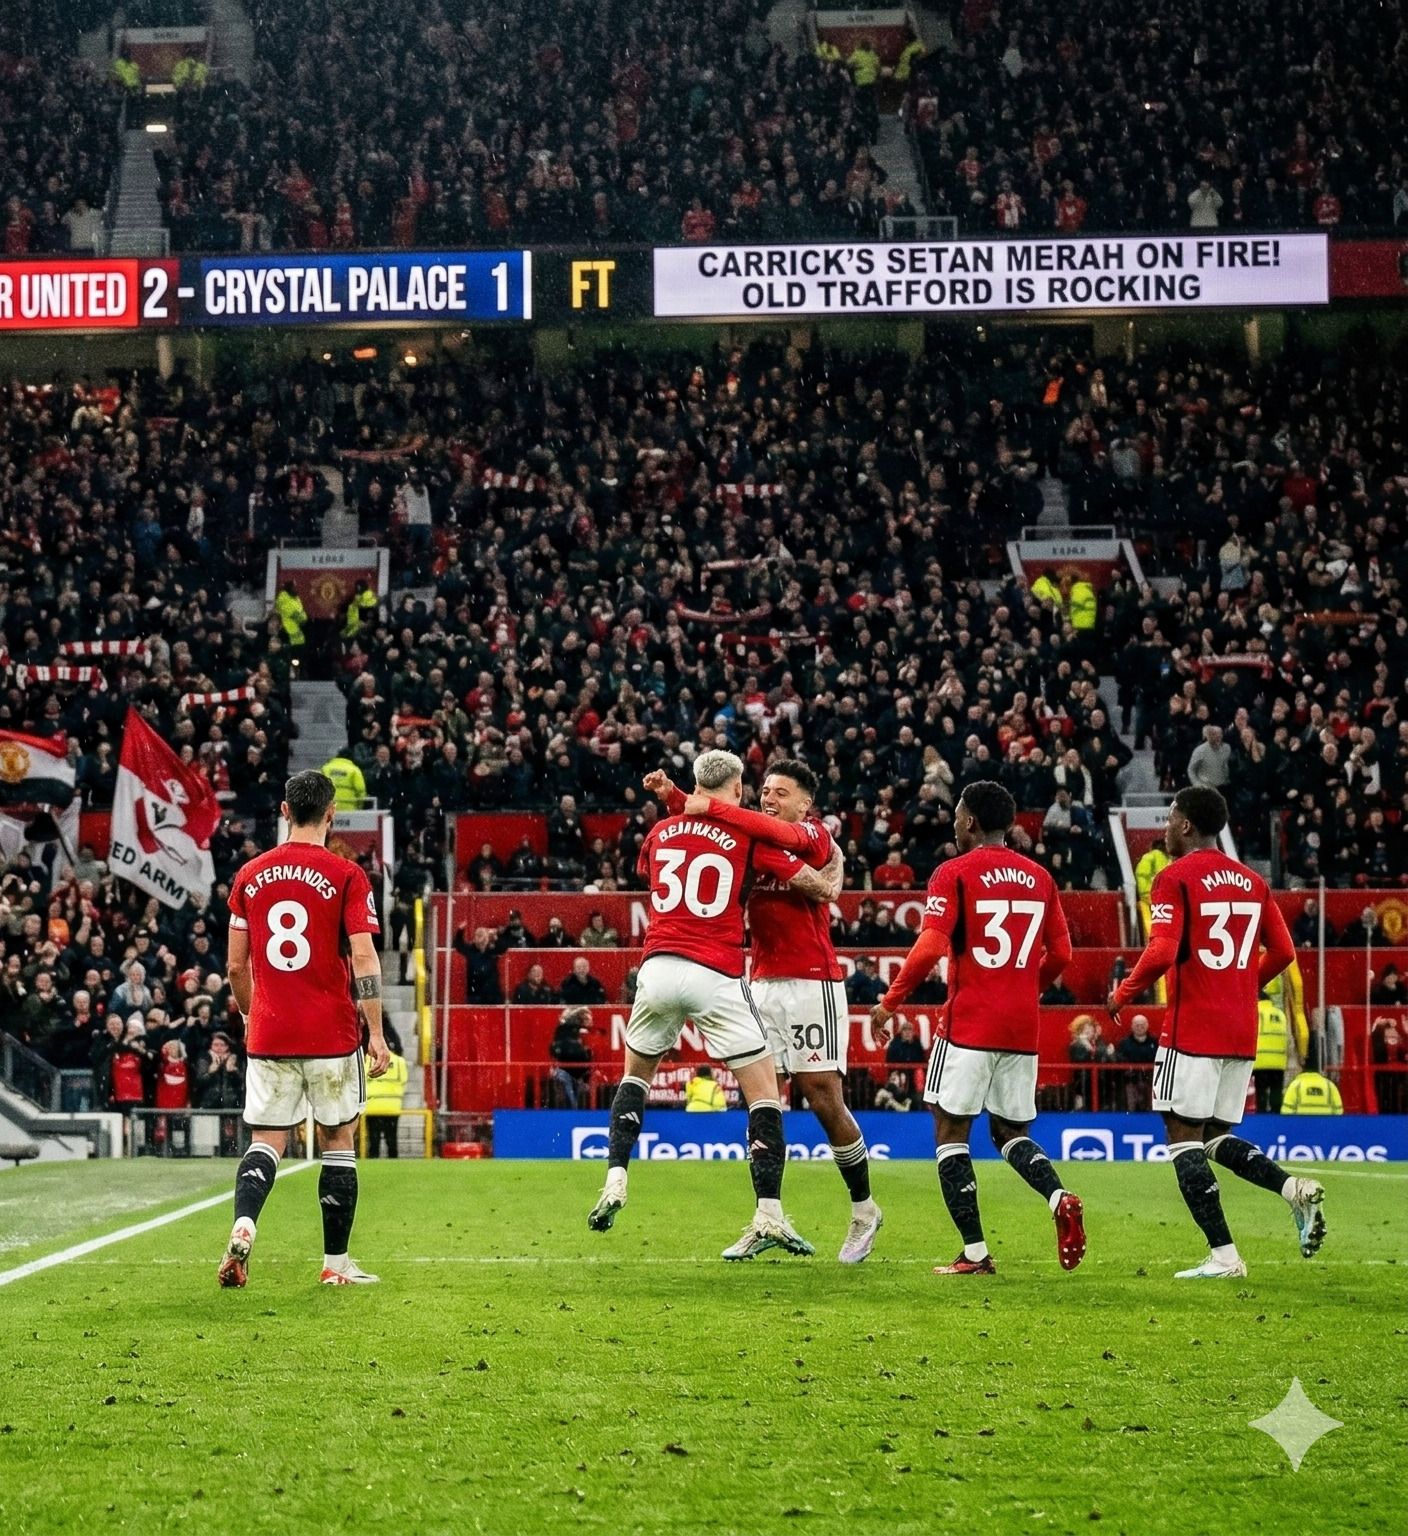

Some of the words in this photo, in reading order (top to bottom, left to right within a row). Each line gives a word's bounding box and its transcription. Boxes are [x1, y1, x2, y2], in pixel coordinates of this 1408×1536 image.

[698, 247, 875, 278] CARRICK'S
[886, 245, 994, 274] SETAN
[1006, 243, 1124, 272] MERAH
[1136, 241, 1184, 269] ON
[1195, 239, 1281, 268] FIRE!
[20, 272, 127, 319] UNITED
[143, 268, 168, 318] 2
[205, 267, 342, 316] CRYSTAL
[348, 265, 467, 312] PALACE
[491, 262, 509, 312] 1
[571, 260, 616, 309] FT
[742, 281, 807, 309] OLD
[816, 278, 993, 307] TRAFFORD
[1004, 277, 1036, 304] IS
[1047, 274, 1202, 303] ROCKING
[650, 848, 734, 919] 30
[979, 867, 1036, 890] MAINOO
[1200, 869, 1253, 893] MAINOO
[265, 899, 311, 972] 8
[971, 899, 1046, 969] 37
[1197, 901, 1262, 970] 37
[790, 1023, 825, 1051] 30
